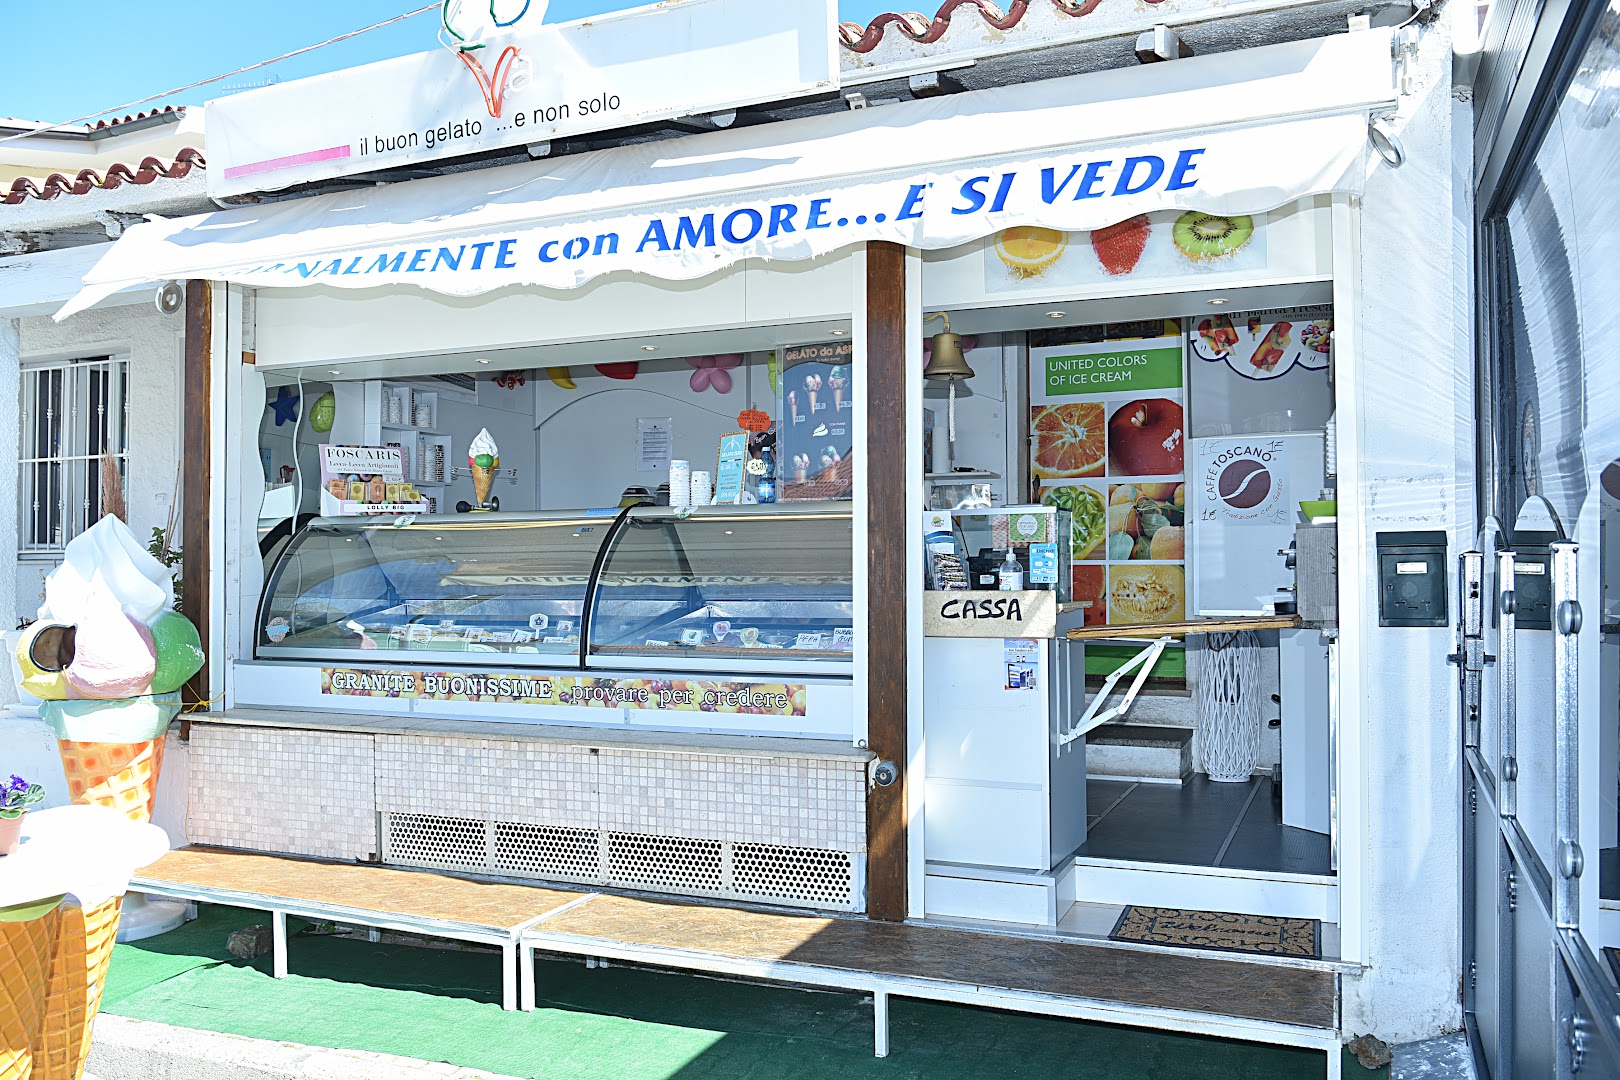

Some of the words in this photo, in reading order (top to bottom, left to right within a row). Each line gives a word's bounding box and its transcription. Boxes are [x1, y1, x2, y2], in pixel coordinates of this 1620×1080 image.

[359, 138, 368, 156] il
[375, 132, 418, 153] buon
[425, 120, 482, 149] gelato
[533, 103, 569, 124] non
[578, 92, 621, 116] solo
[538, 232, 621, 263] con
[951, 172, 1018, 215] SI
[1040, 148, 1207, 205] VEDE
[786, 347, 818, 360] GELATO
[820, 347, 833, 356] da
[1049, 359, 1094, 371] UNITED
[1097, 354, 1147, 368] COLORS
[1049, 375, 1066, 386] OF
[1069, 374, 1087, 384] ICE
[1089, 370, 1132, 383] CREAM
[327, 448, 401, 460] FOSCARIS
[1212, 446, 1271, 468] TOSCANO
[941, 598, 1022, 621] CASSA
[331, 671, 416, 693] GRANITE
[424, 676, 553, 698] BUONISSIME
[570, 685, 649, 705] provare
[659, 689, 694, 708] per
[703, 687, 788, 709] credere
